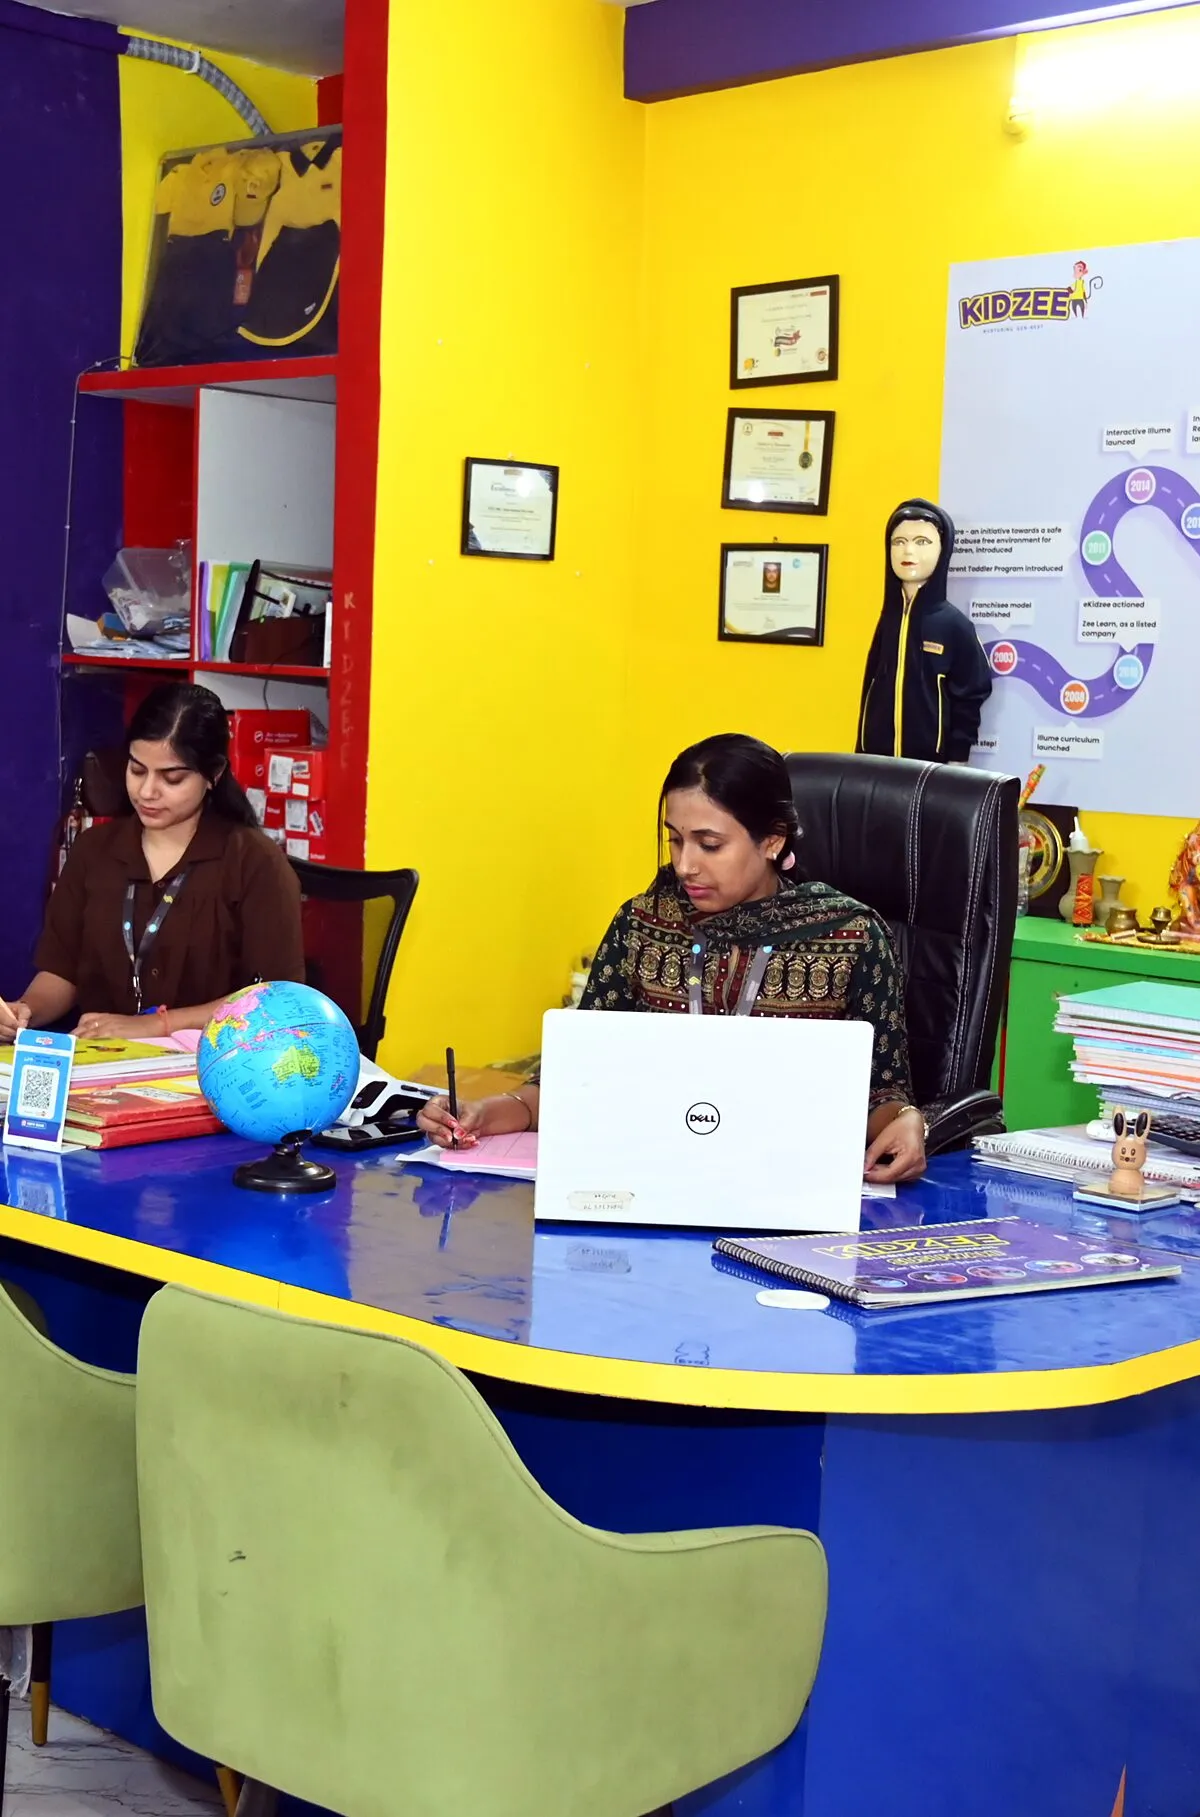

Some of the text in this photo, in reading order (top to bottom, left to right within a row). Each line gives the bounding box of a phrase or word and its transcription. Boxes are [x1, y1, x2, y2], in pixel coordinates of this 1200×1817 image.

[960, 288, 1070, 328] KIDZEE
[1105, 427, 1146, 436] Interactive
[1104, 437, 1136, 446] launced
[1131, 479, 1151, 492] 2014
[993, 564, 1024, 574] Program
[1080, 630, 1117, 639] company
[994, 652, 1013, 663] 2003
[1065, 692, 1084, 702] 2008
[1059, 735, 1100, 744] curriculum
[1036, 743, 1070, 752] launched
[690, 1114, 716, 1123] DELL
[813, 1234, 1010, 1259] KIDZEE
